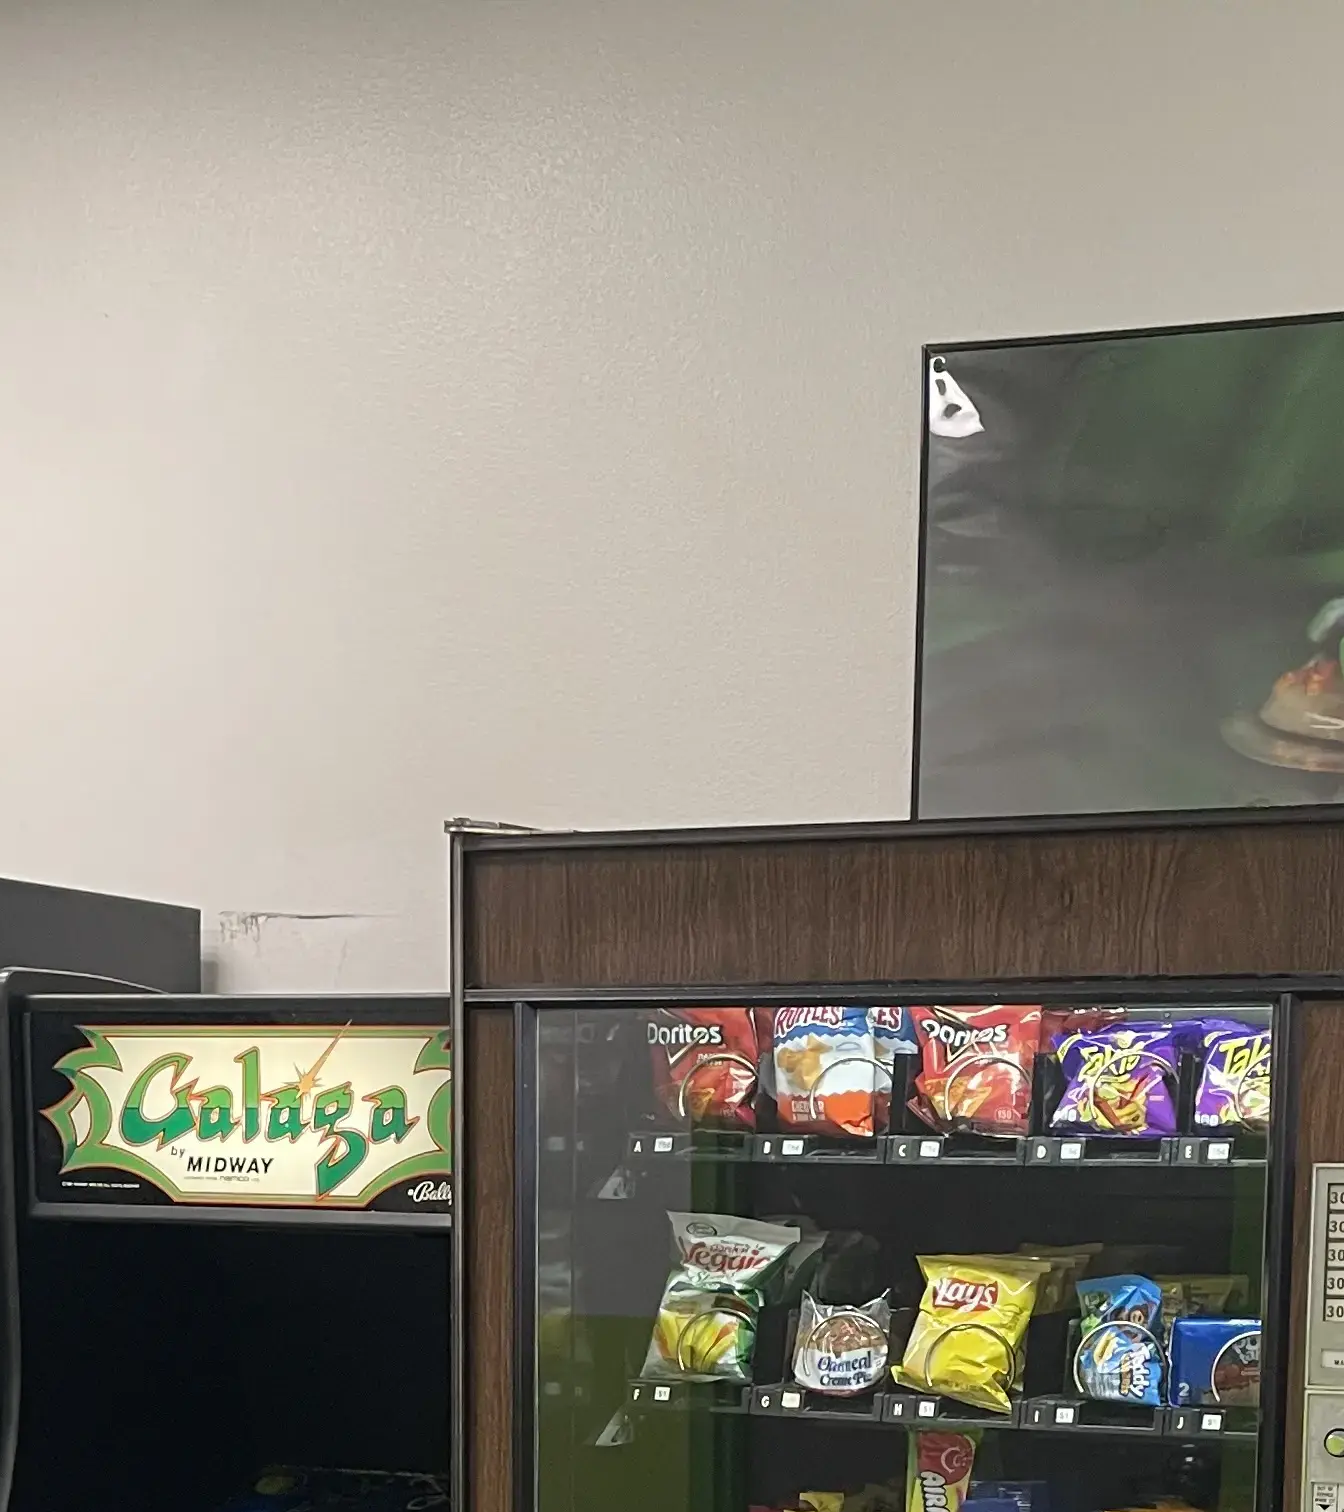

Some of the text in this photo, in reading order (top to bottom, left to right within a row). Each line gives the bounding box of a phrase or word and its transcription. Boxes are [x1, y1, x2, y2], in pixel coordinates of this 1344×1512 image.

[647, 1022, 723, 1045] Doritos
[119, 1046, 421, 1203] Galaga
[171, 1146, 185, 1158] by
[634, 1141, 642, 1153] A
[187, 1156, 274, 1174] MIDWAY
[632, 1389, 640, 1401] F
[1178, 1382, 1190, 1397] 2
[761, 1395, 770, 1408] G
[893, 1403, 903, 1416] H
[1176, 1416, 1184, 1430] J
